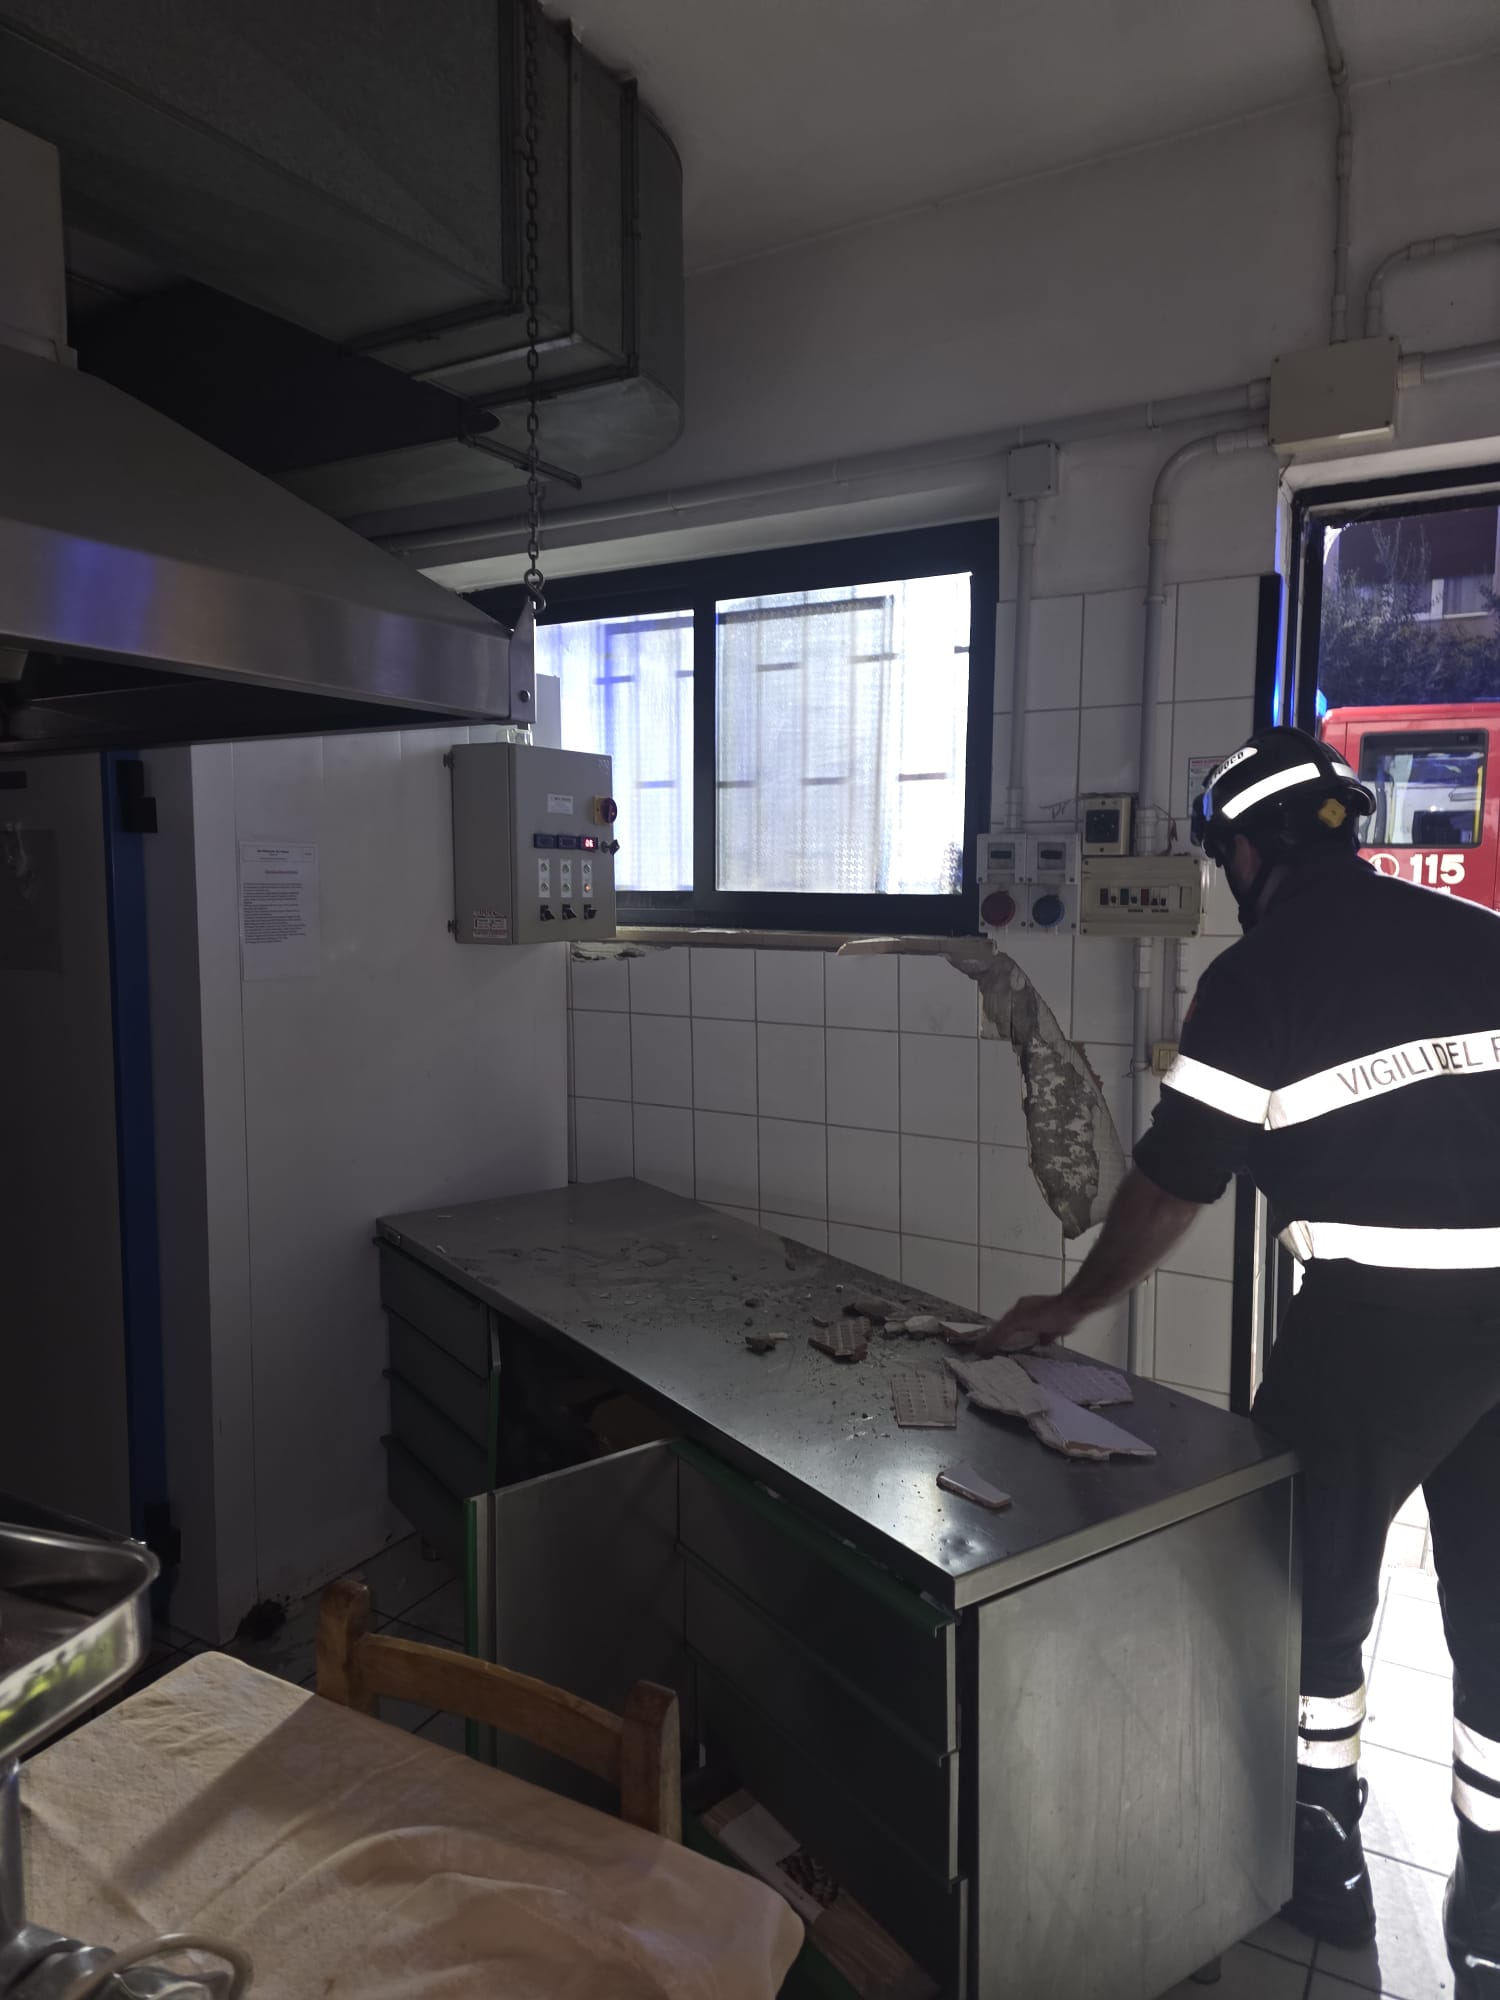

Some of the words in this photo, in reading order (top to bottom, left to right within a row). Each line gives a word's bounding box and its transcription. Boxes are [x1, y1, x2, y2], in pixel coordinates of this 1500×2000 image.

[1409, 853, 1466, 885] 115
[1336, 1046, 1434, 1095] VIGILI
[1432, 1041, 1483, 1070] DEL
